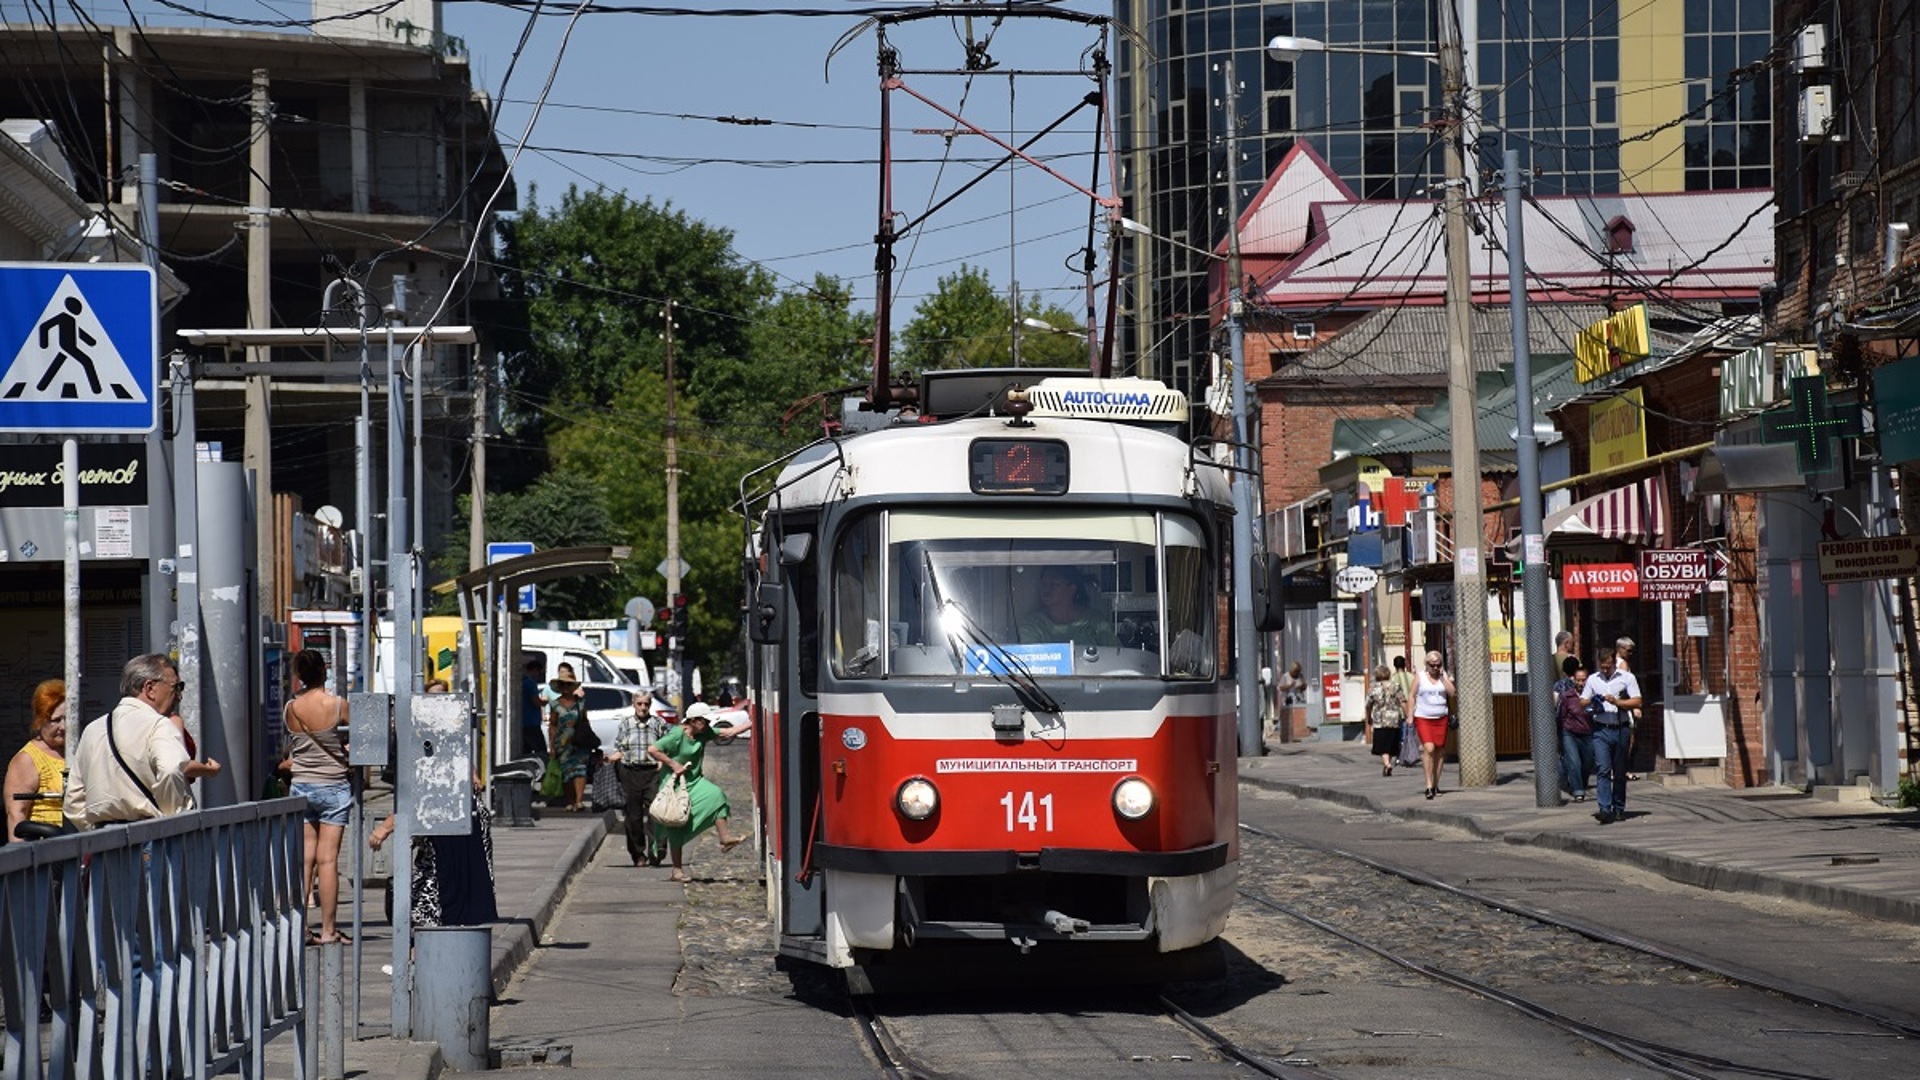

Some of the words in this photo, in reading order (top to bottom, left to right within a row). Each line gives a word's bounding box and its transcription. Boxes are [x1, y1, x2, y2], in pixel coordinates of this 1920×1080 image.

[1063, 390, 1151, 406] AUTOCLIMA
[1007, 444, 1030, 481] 2
[1822, 541, 1870, 556] РЕМОНТ
[1872, 538, 1913, 552] ОБУВИ
[1651, 553, 1699, 563] РЕМОНТ
[1835, 555, 1900, 568] покраска
[1645, 564, 1707, 579] ОБУВИ
[1643, 591, 1691, 600] ИЗДЕЛИЙ
[975, 649, 991, 675] 2
[939, 760, 1058, 772] МУНИЦИПАЛЬНЫЙ
[1060, 760, 1135, 771] ТРАНСПОРТ
[1000, 791, 1054, 832] 141
